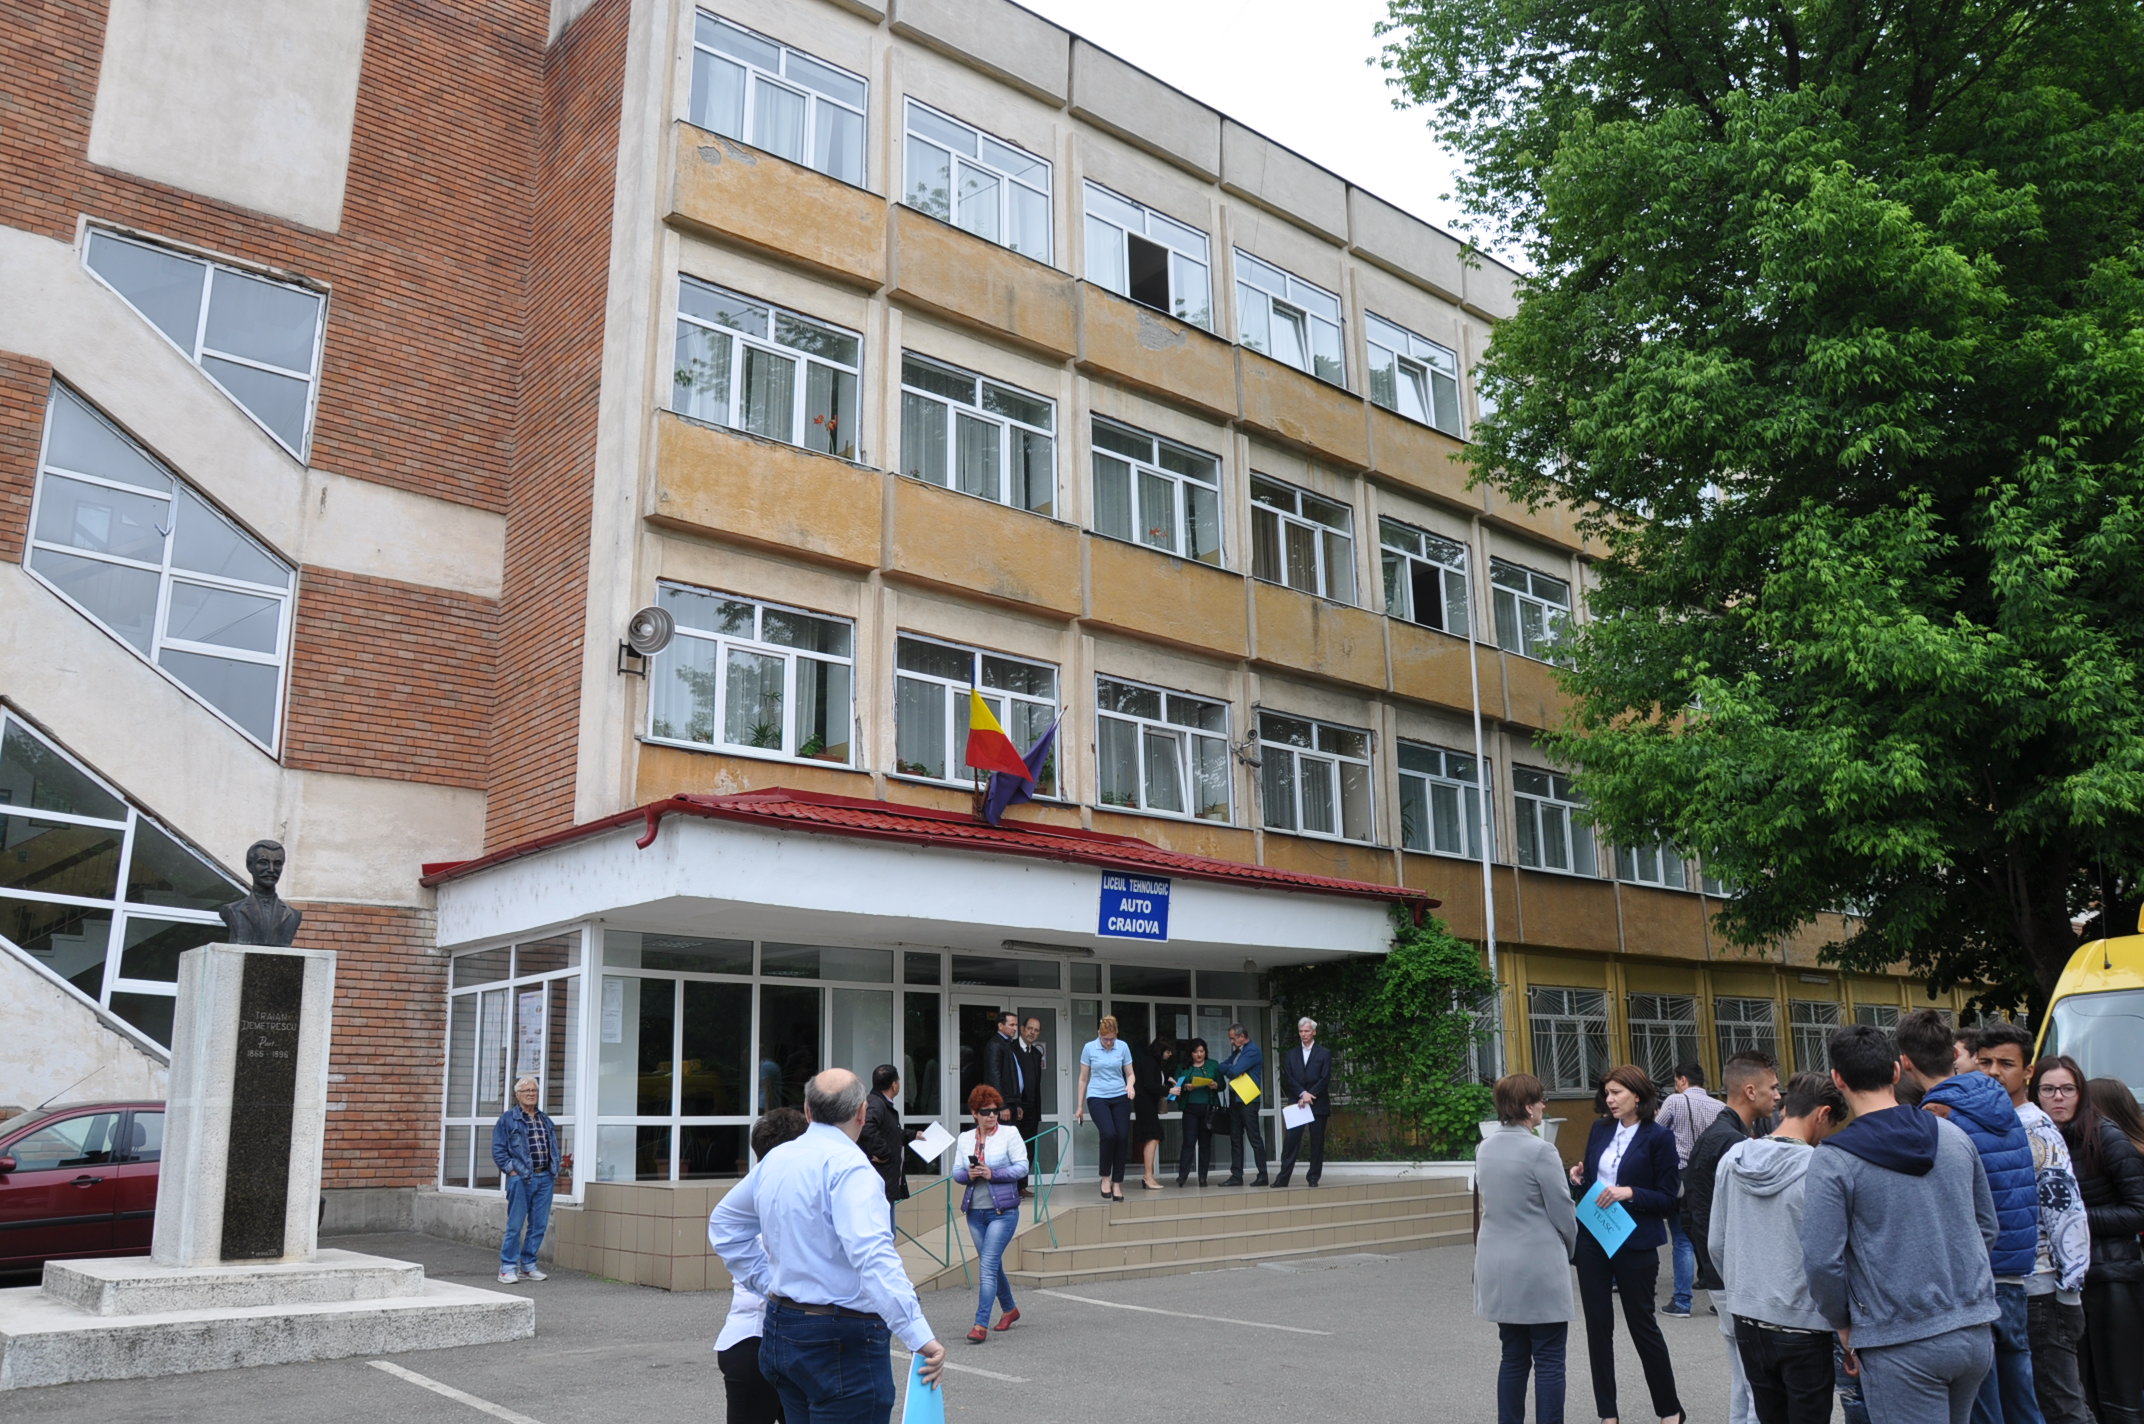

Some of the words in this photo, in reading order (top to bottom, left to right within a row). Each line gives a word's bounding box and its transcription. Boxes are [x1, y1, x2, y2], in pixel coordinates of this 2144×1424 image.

[1103, 875, 1126, 891] LICEUL
[1129, 879, 1168, 896] TEHNOLOGIC
[1119, 897, 1152, 914] AUTO
[1107, 916, 1160, 935] CRAIOVA
[255, 1011, 288, 1021] TRAIAN
[240, 1020, 297, 1031] DEMETRESCU
